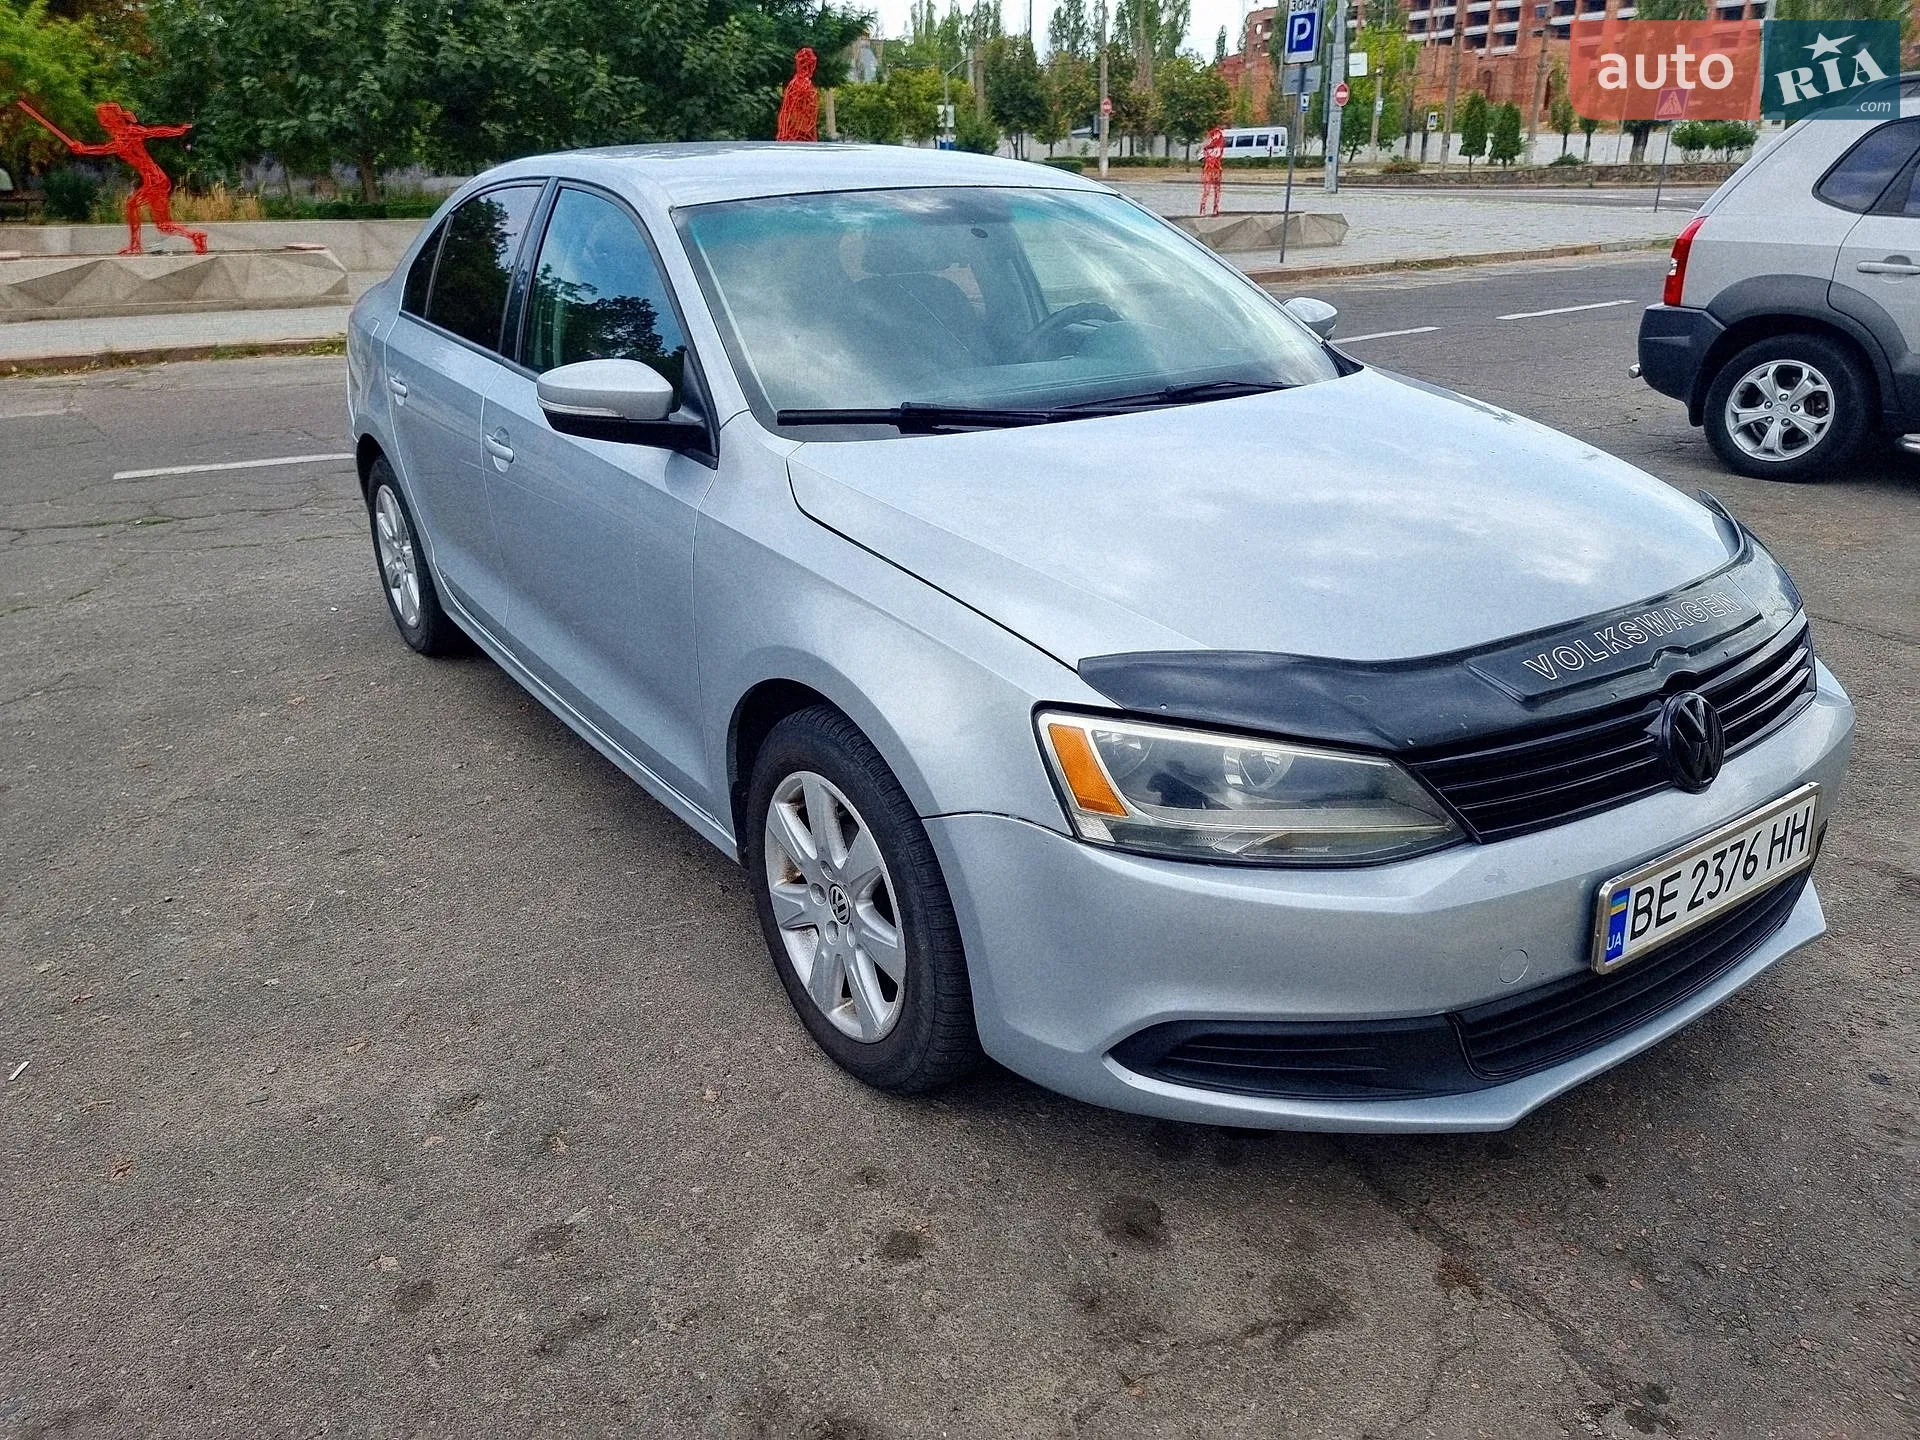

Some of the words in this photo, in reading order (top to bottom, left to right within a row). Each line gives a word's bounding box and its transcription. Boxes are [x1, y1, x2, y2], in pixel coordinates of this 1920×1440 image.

[1292, 17, 1311, 50] P
[1522, 591, 1743, 681] VOLKSWAGEN
[1629, 869, 1682, 942] BE
[1686, 829, 1763, 913] 2376
[1766, 805, 1811, 871] HH
[1606, 931, 1623, 951] UA
